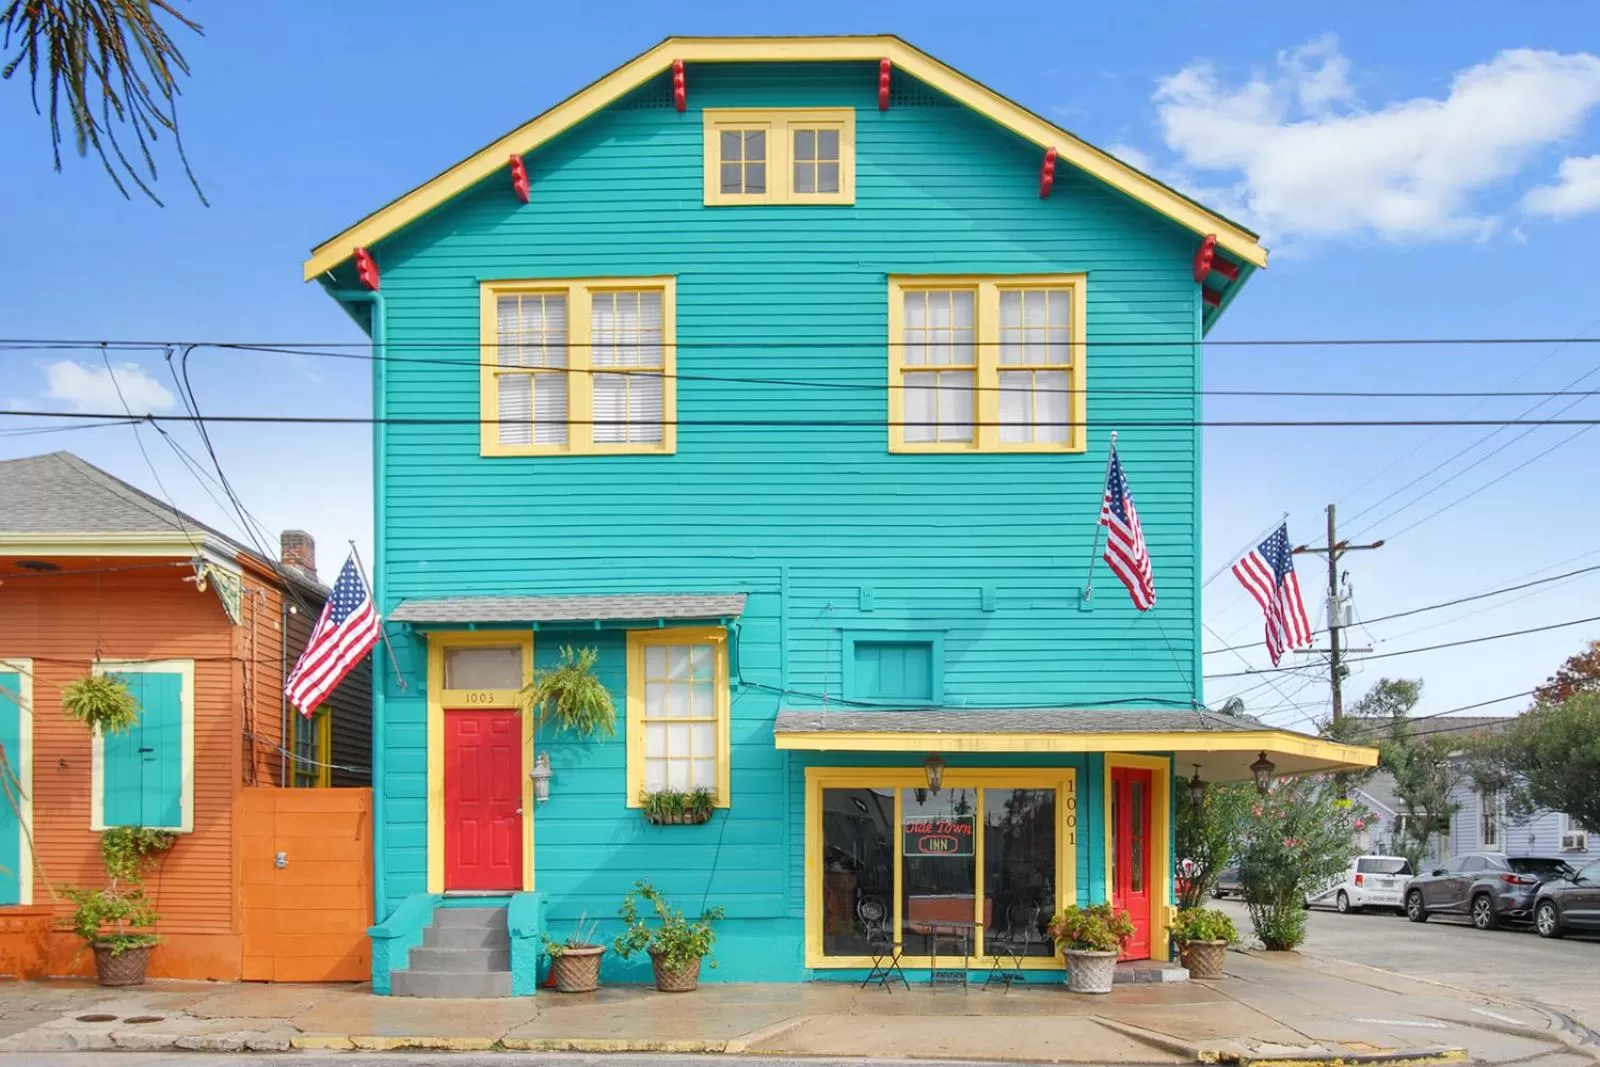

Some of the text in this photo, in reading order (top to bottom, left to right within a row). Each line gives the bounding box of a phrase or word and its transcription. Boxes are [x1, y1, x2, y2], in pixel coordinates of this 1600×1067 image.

[466, 692, 494, 704] 1003
[1067, 779, 1076, 845] 1001
[936, 820, 972, 835] Town
[929, 838, 948, 851] INN
